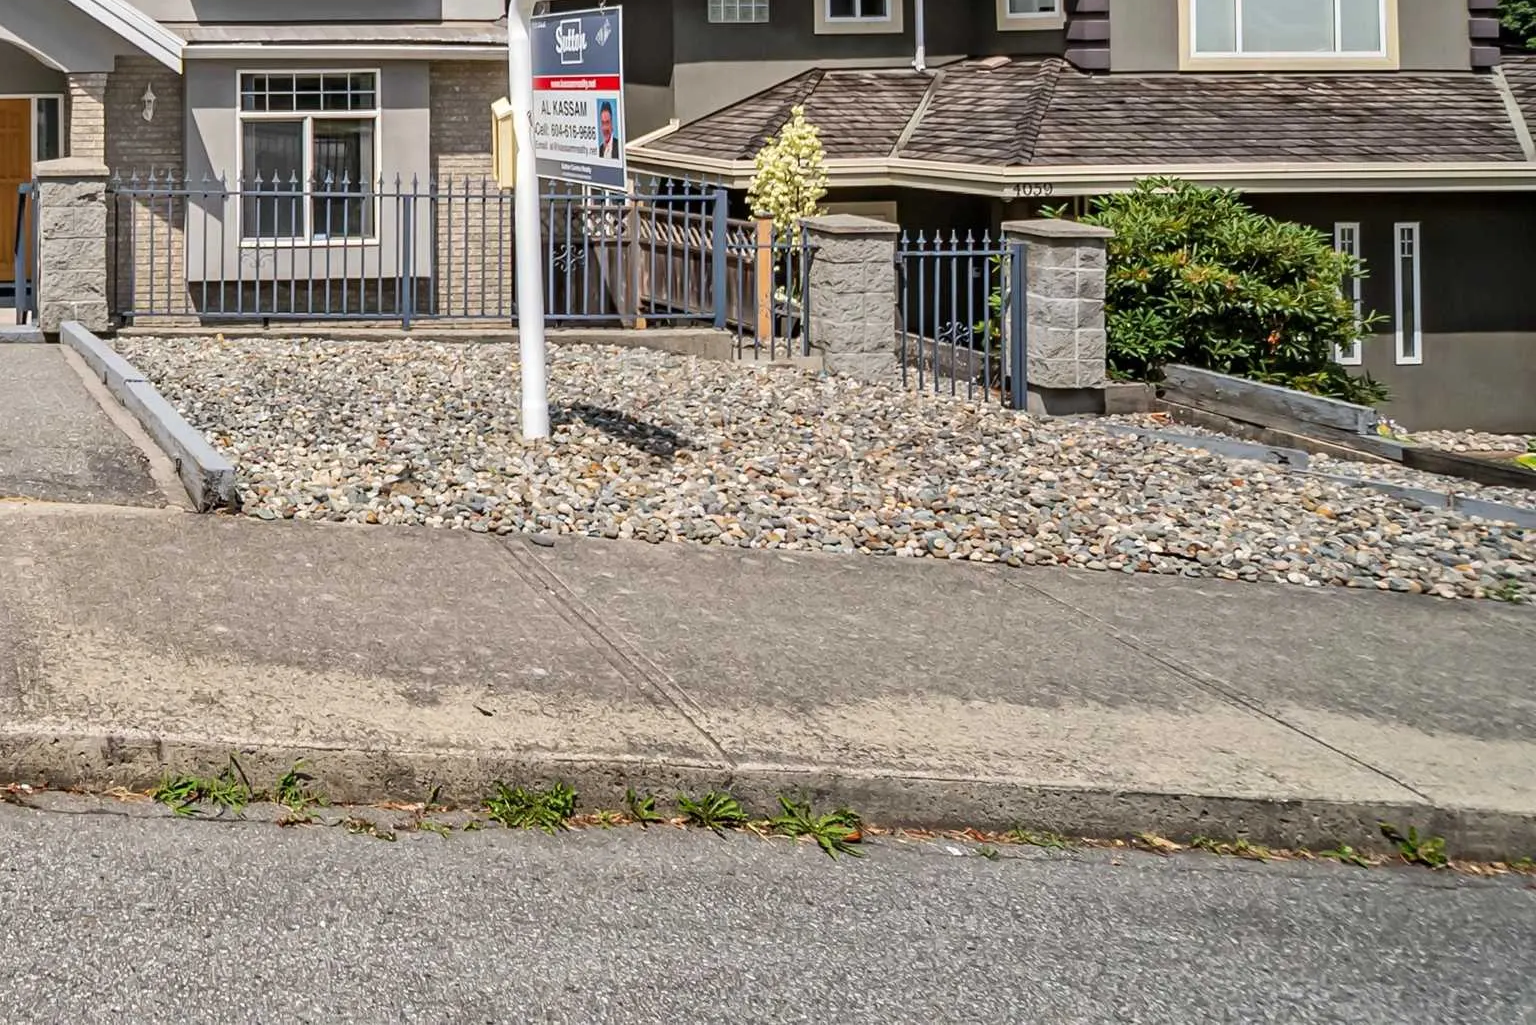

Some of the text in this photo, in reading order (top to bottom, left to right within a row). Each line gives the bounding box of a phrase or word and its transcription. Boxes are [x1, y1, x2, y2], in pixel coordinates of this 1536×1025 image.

[555, 27, 587, 53] Sutton
[541, 100, 587, 117] AL KASSAM
[1013, 182, 1053, 196] 4059
